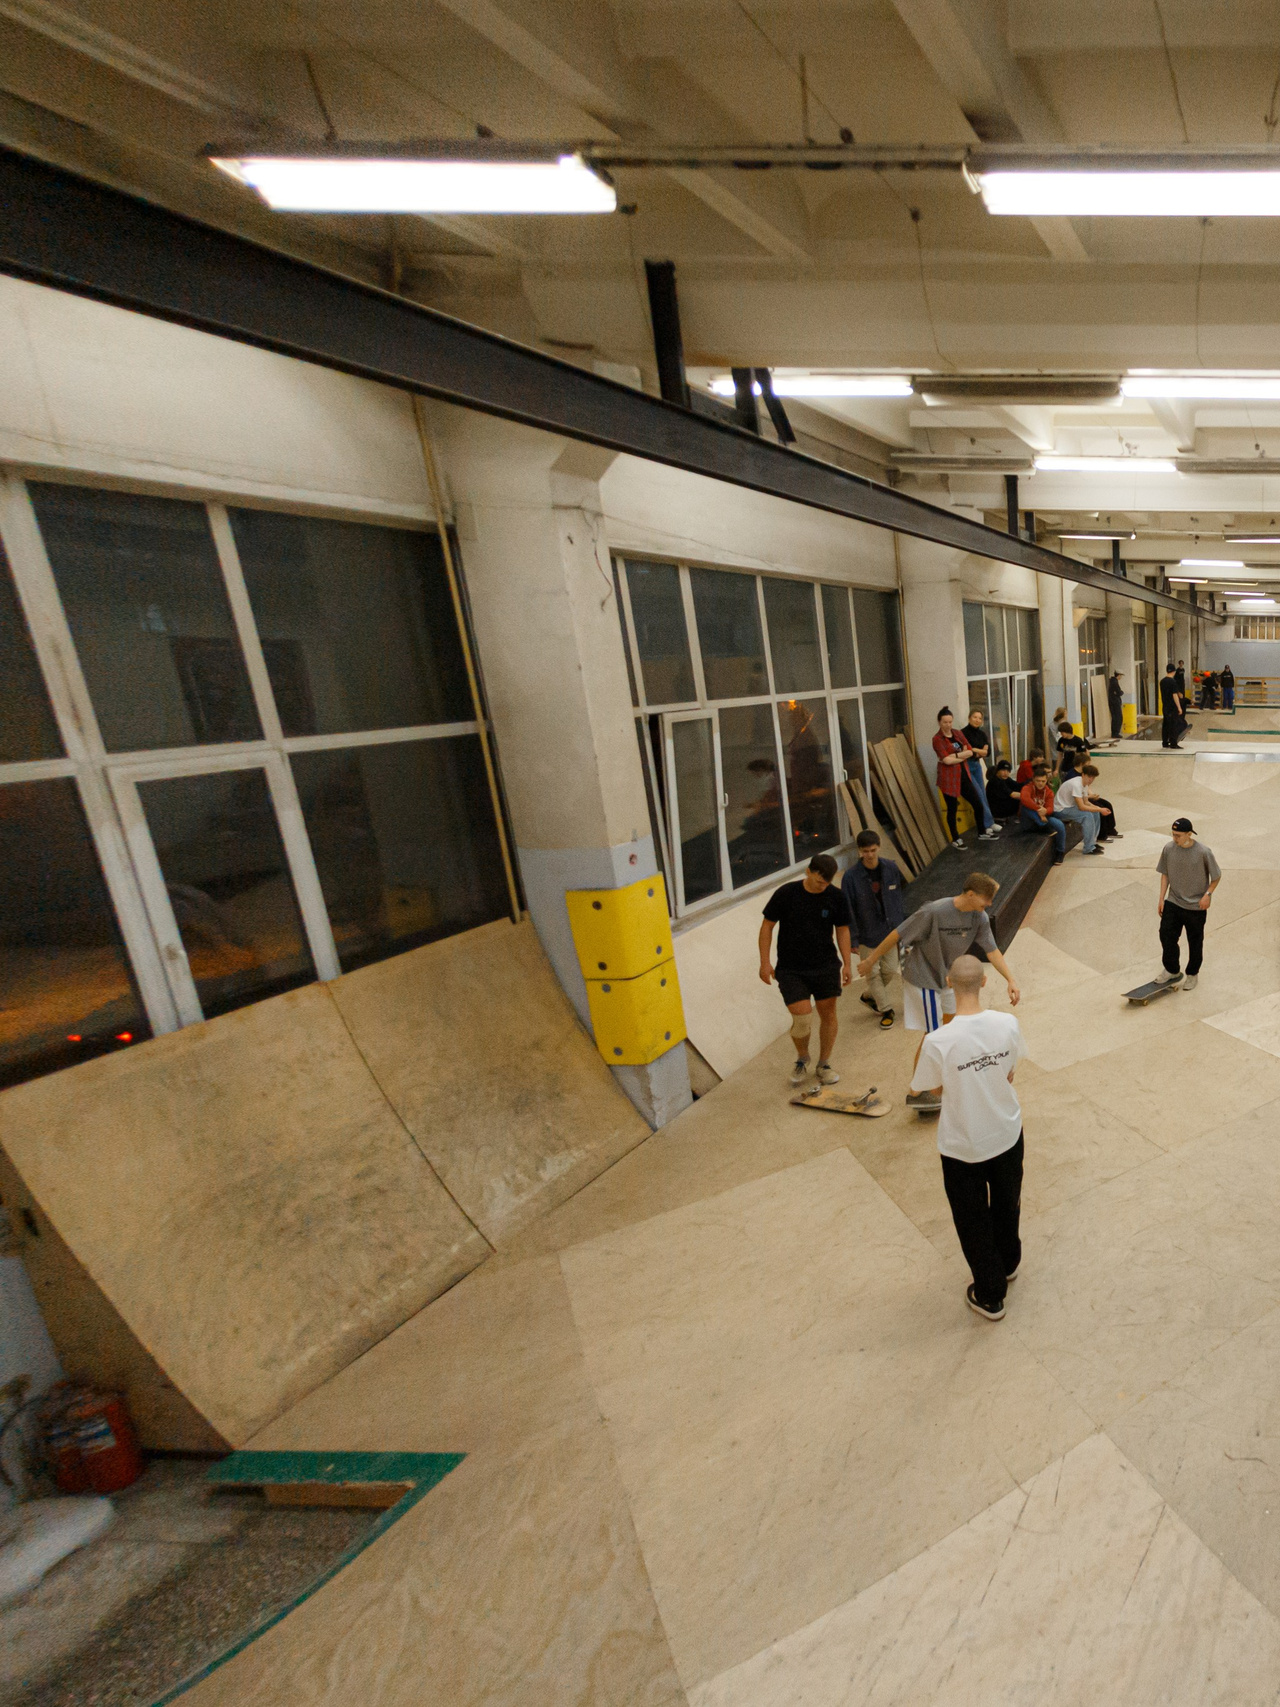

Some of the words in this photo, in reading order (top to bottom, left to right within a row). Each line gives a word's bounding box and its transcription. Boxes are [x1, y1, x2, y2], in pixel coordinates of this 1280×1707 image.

[957, 1055, 991, 1071] SUPPORT
[993, 1051, 1010, 1060] YOUR
[974, 1061, 999, 1071] LOCAL
